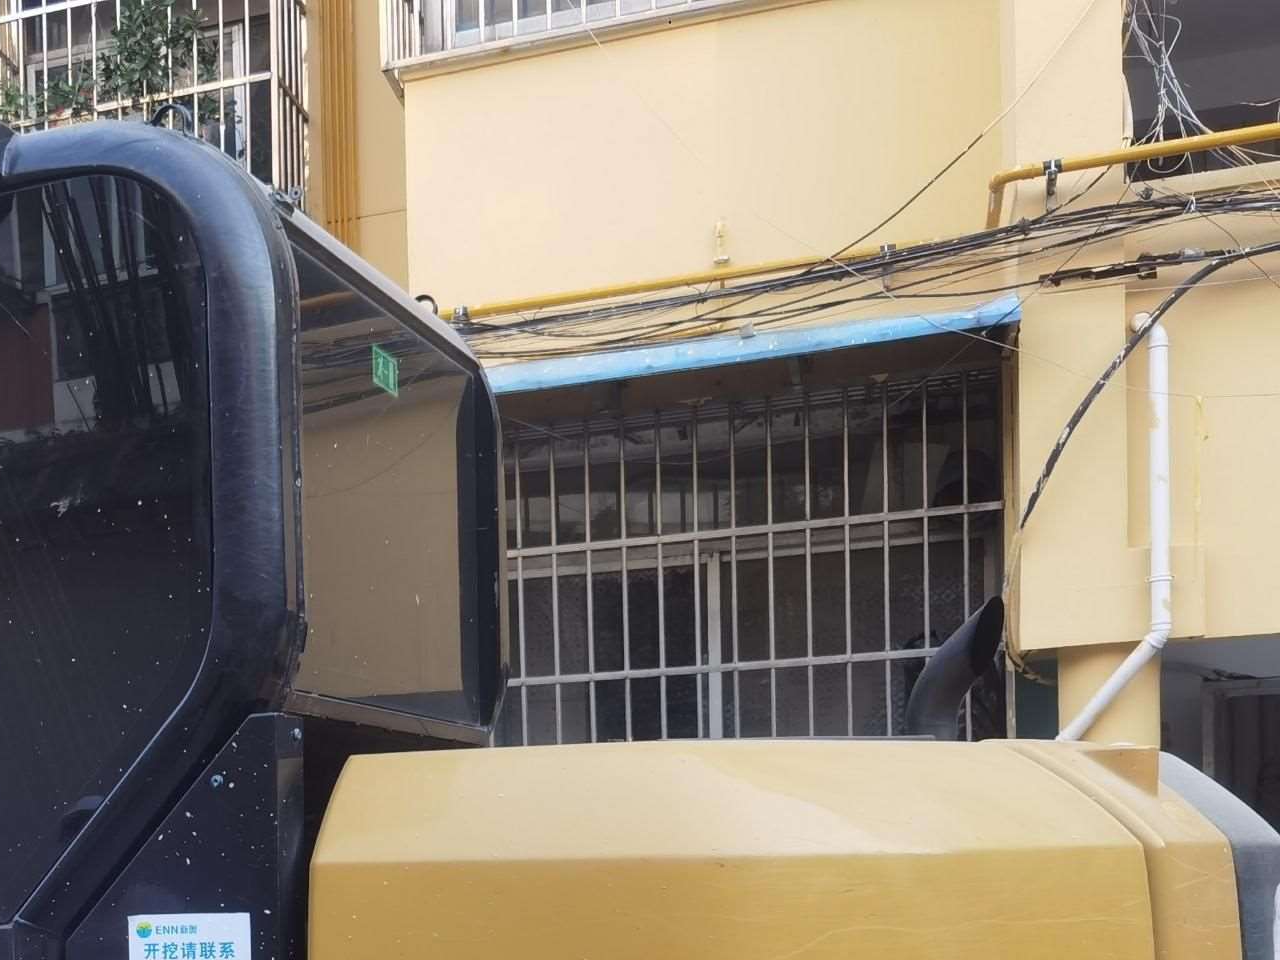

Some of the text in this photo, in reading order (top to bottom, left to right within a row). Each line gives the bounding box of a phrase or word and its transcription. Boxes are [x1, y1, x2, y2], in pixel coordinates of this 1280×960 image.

[155, 925, 178, 935] ENN
[143, 941, 236, 960] 开挖请联系
